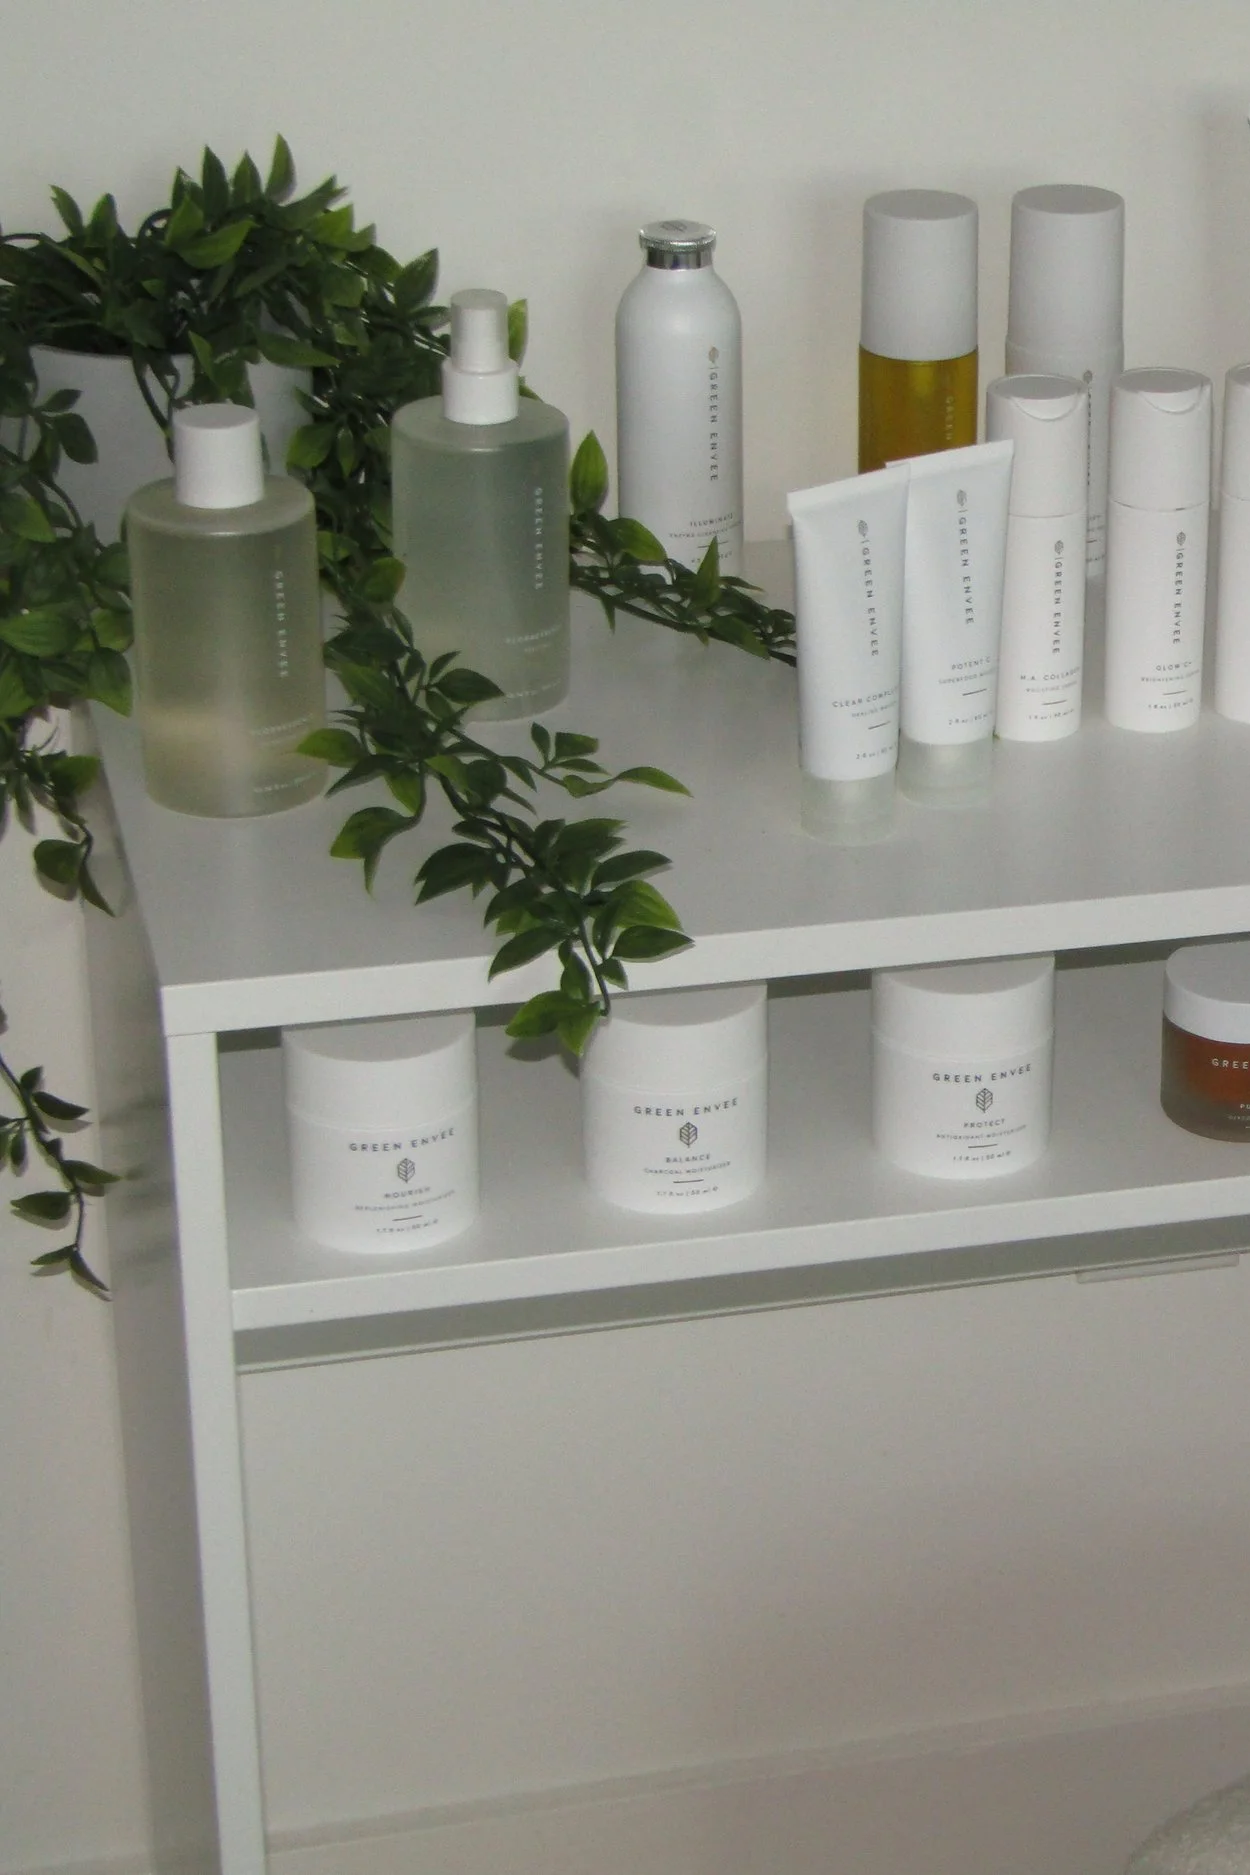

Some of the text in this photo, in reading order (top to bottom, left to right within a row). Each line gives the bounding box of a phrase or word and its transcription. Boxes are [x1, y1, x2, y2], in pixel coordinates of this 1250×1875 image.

[709, 371, 719, 482] GREEN ENVEE
[958, 516, 975, 625] GREEN ENVEE
[862, 546, 879, 657] GREEN ENVEE
[1052, 560, 1064, 655] GREEN ENVEE
[1172, 551, 1184, 645] GREEN ENVEE
[932, 1063, 1032, 1083] GREEN ENVEE
[633, 1097, 739, 1117] GREEN ENVEE
[963, 1118, 1006, 1129] PROTECT
[349, 1127, 455, 1152] GREEN ENVEE
[665, 1153, 712, 1164] BALANCE
[384, 1186, 431, 1199] NOURISH
